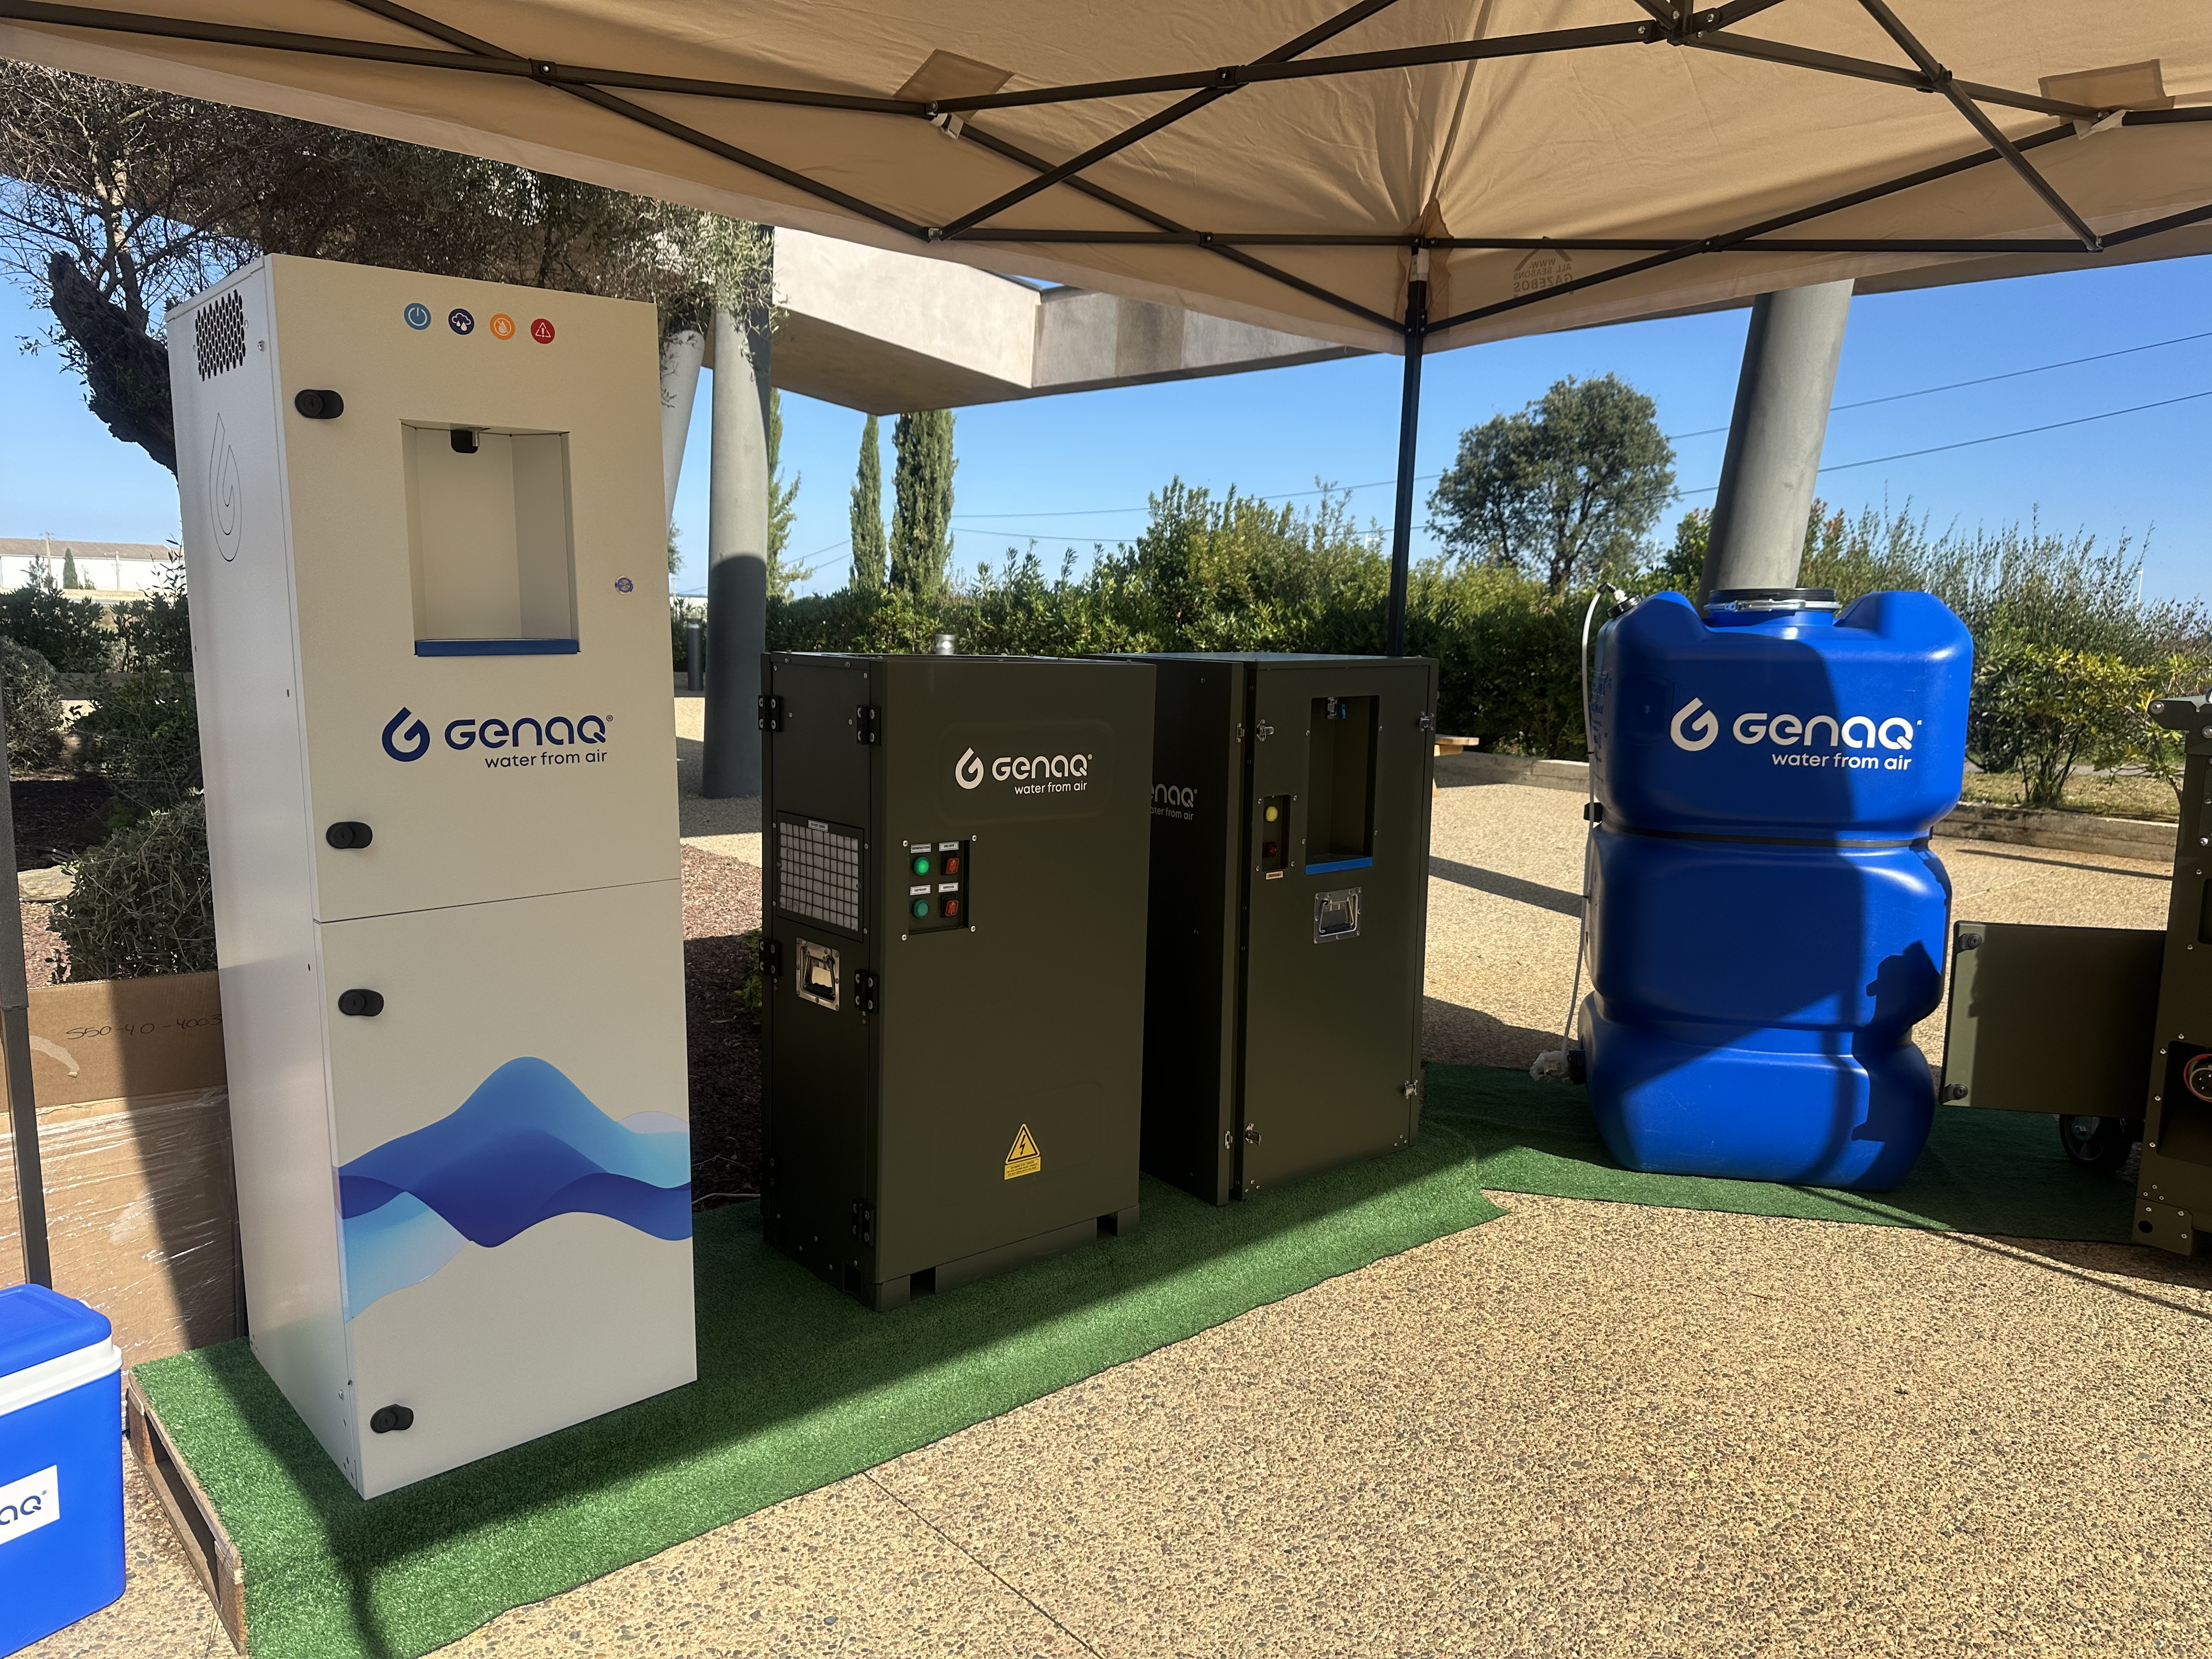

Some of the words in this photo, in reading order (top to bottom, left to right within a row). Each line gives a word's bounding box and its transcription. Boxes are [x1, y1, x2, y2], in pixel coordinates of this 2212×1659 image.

[485, 754, 537, 768] water
[540, 752, 580, 765] from
[585, 749, 607, 763] air
[1772, 754, 1830, 767] water
[1833, 752, 1878, 769] from
[1884, 754, 1912, 770] air
[1015, 785, 1045, 795] water
[1047, 782, 1071, 793] from
[1074, 780, 1087, 791] air
[1165, 807, 1182, 819] from
[1183, 811, 1194, 821] air
